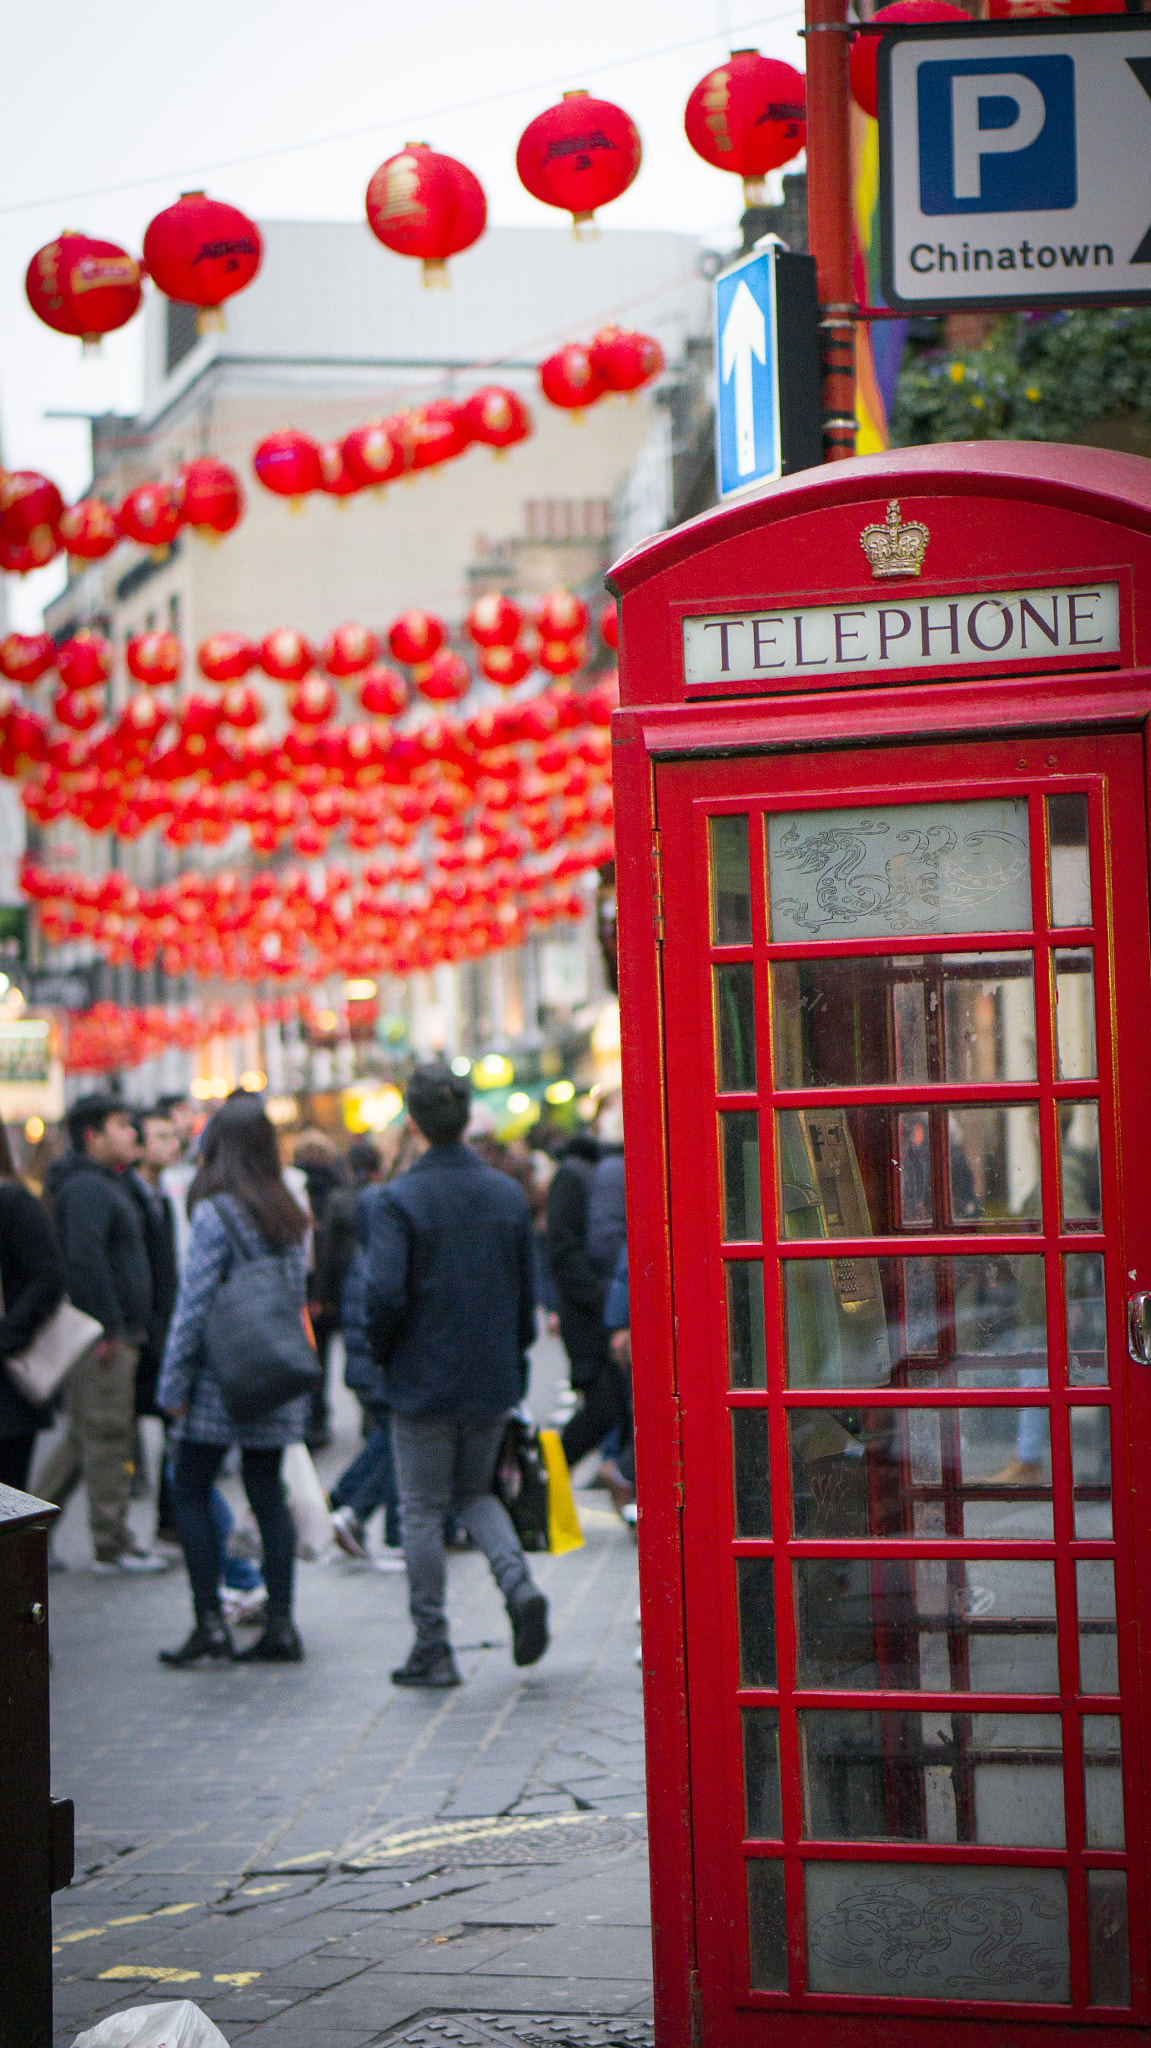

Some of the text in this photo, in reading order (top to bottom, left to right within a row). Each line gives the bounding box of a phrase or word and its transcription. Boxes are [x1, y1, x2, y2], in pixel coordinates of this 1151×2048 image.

[952, 72, 1046, 198] P
[909, 240, 1114, 274] Chinatown
[703, 592, 1104, 672] TELEPHONE
